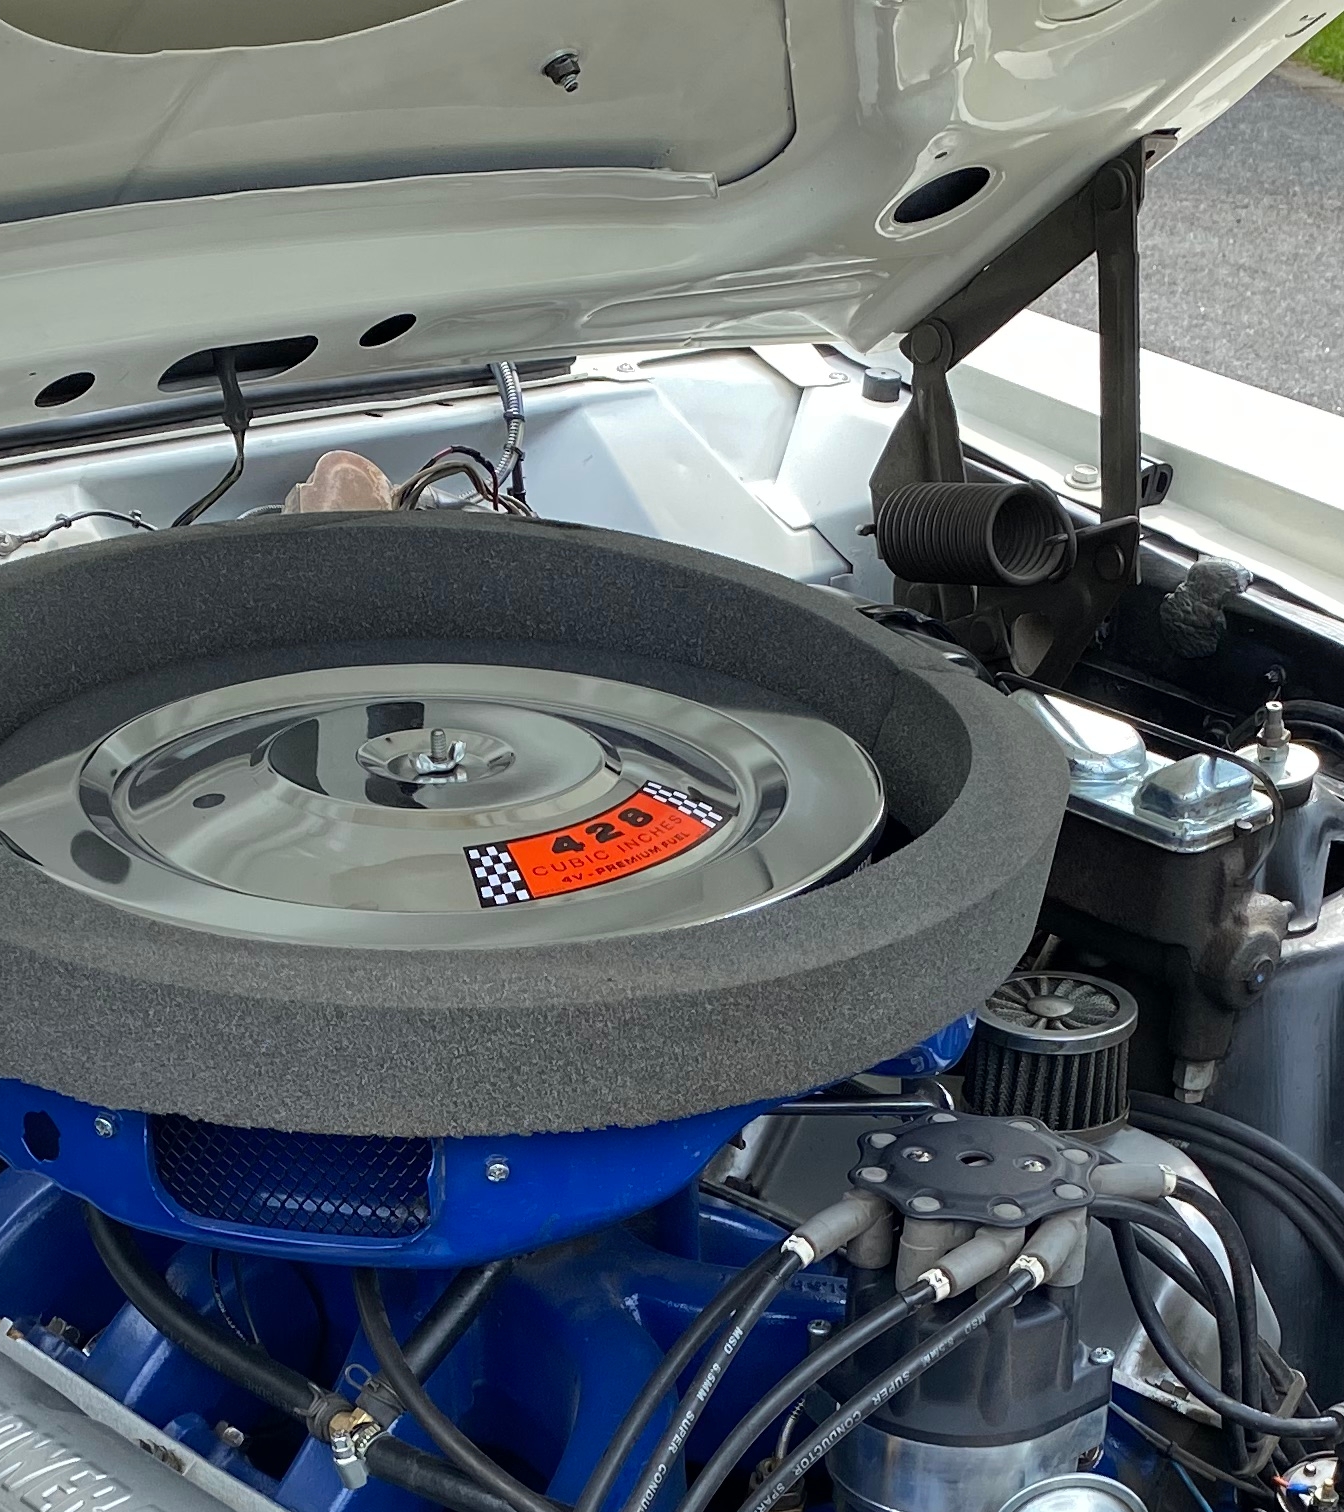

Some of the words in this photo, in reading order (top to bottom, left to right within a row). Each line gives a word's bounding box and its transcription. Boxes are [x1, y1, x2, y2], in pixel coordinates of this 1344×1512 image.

[532, 850, 610, 877] CUBIC
[618, 814, 683, 854] INCHES
[551, 807, 654, 854] 428
[596, 845, 662, 876] PREMIUM
[661, 830, 690, 849] FUEL
[723, 1325, 744, 1356] MSD
[870, 1370, 911, 1406] SUPER
[667, 1409, 696, 1455] SUPER
[791, 1410, 862, 1476] CONDUCTOR
